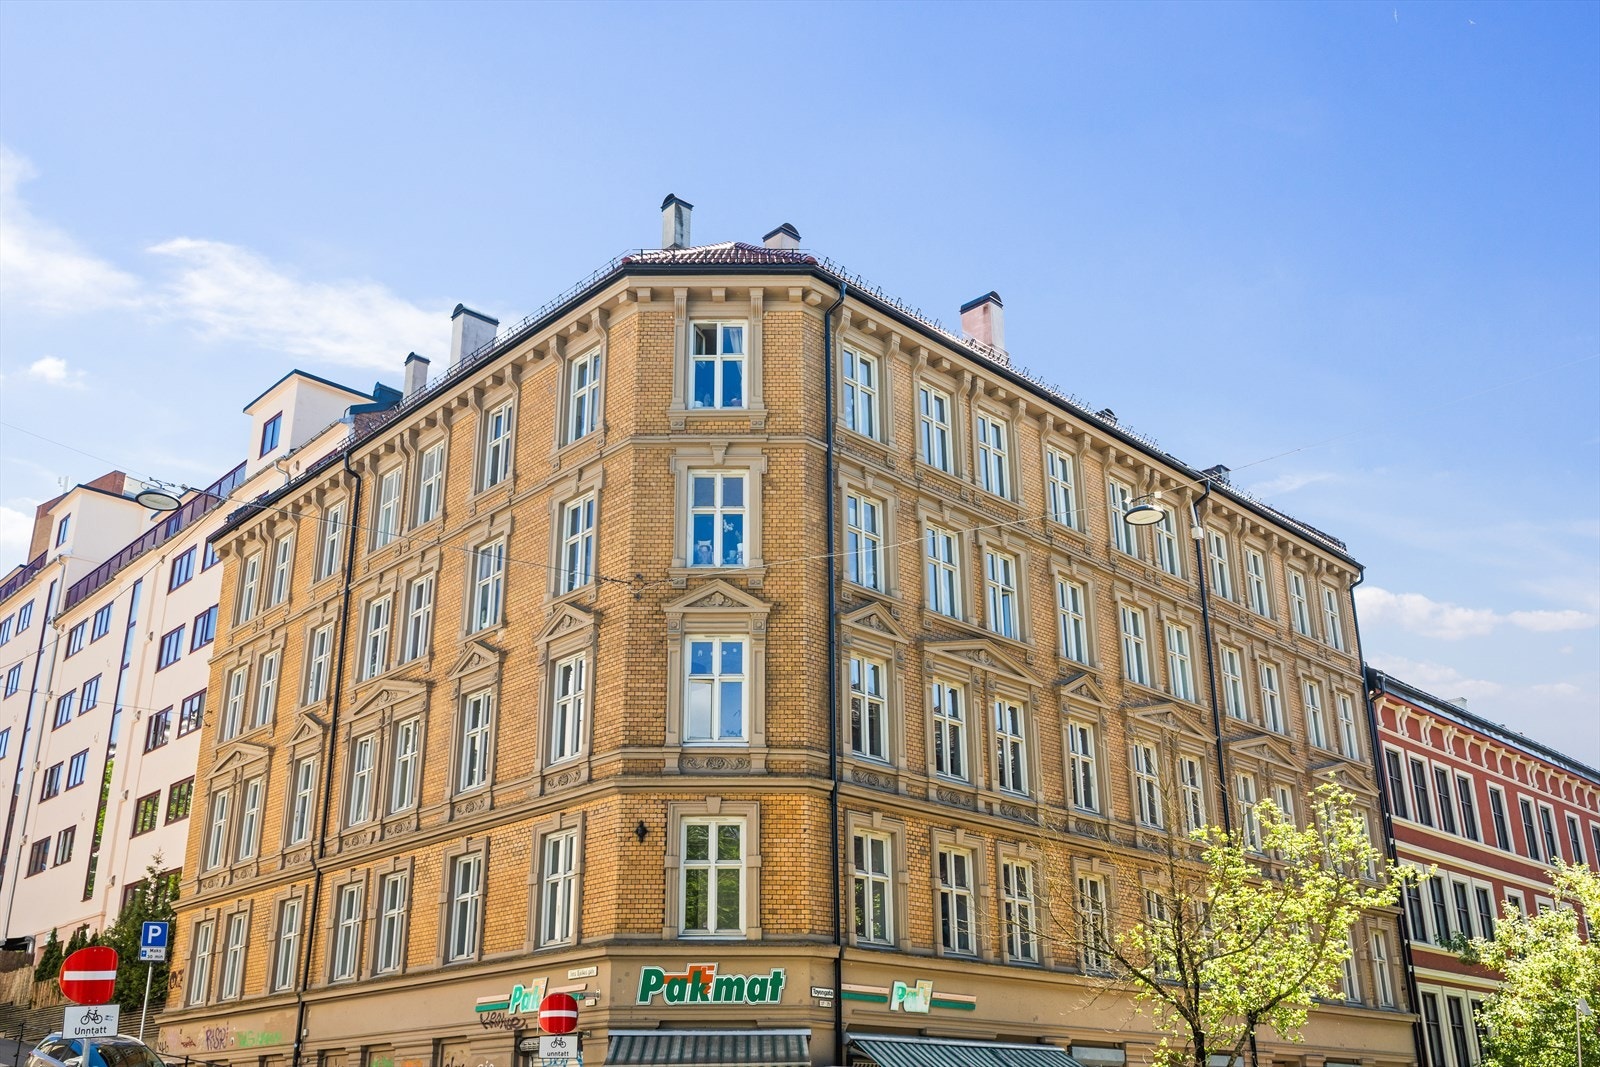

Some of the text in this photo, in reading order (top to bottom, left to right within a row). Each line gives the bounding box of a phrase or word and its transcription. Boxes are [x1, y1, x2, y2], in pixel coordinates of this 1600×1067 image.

[148, 925, 162, 944] P
[637, 966, 785, 1005] Pakmat
[74, 1026, 107, 1036] Unntatt
